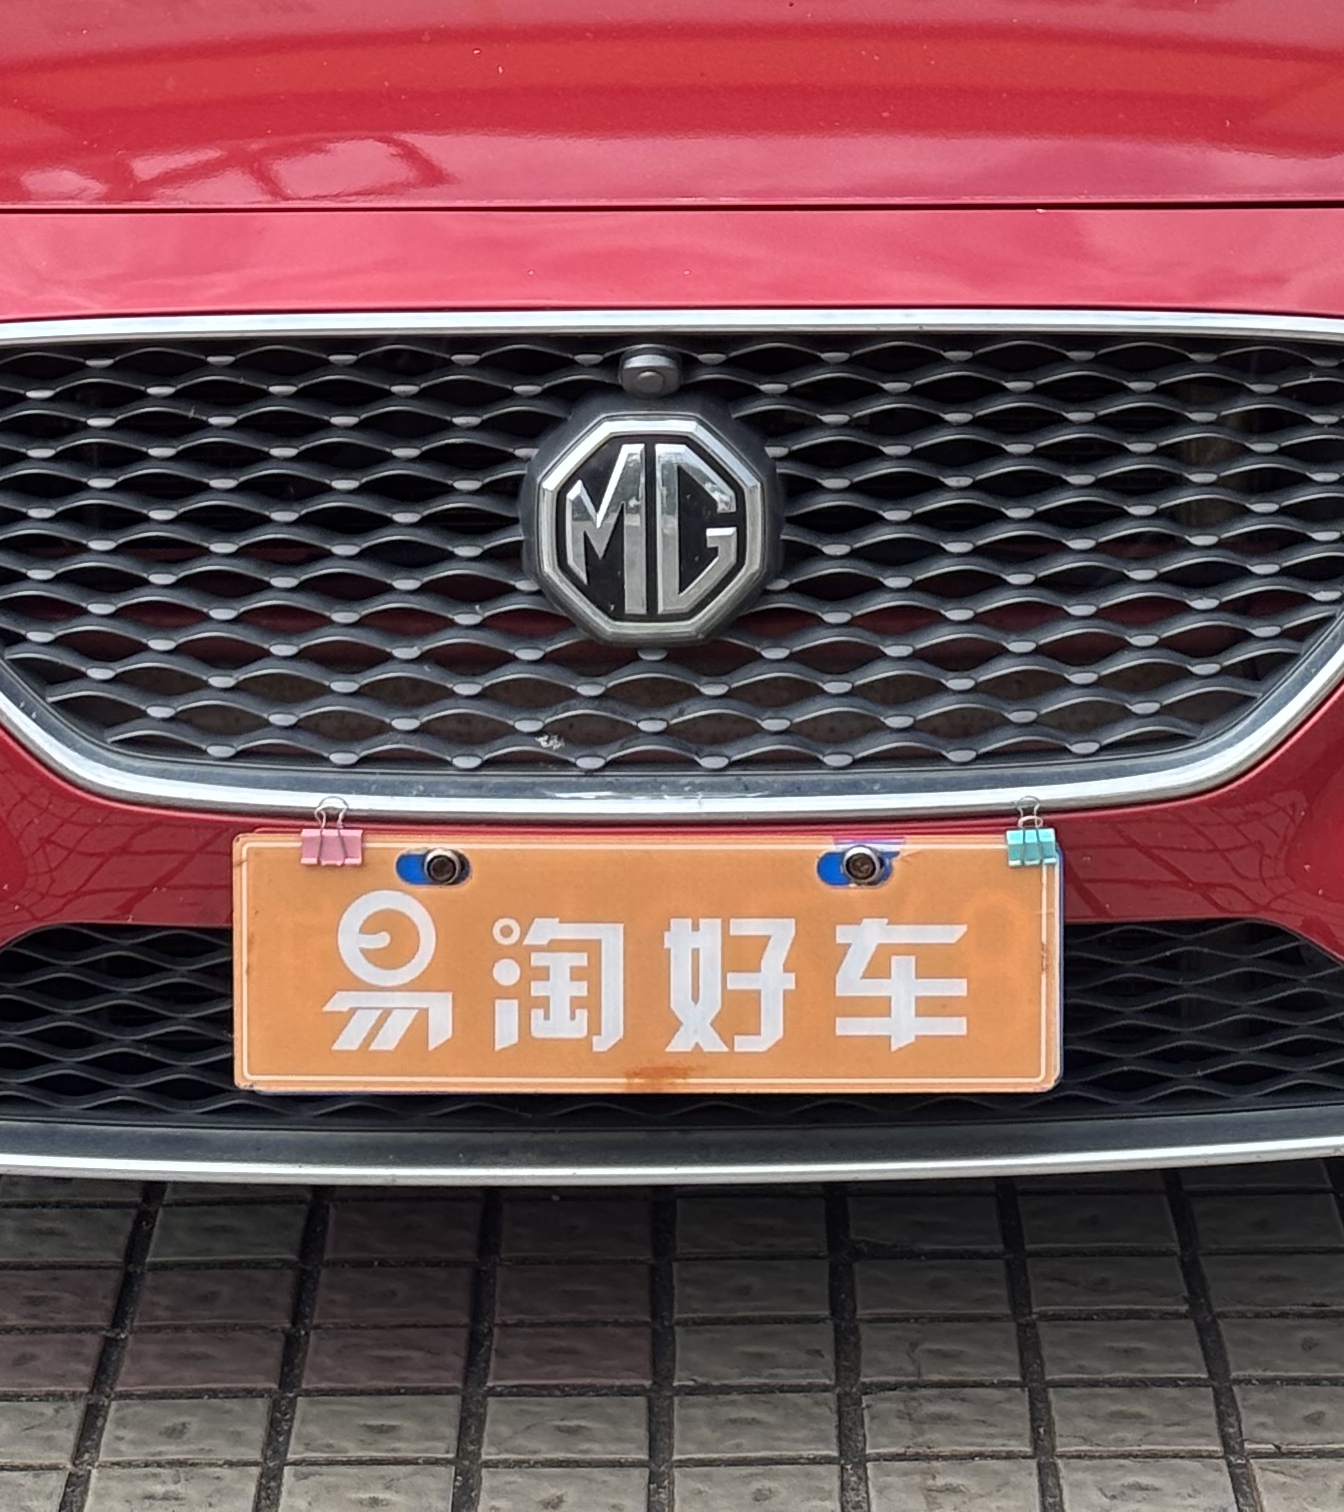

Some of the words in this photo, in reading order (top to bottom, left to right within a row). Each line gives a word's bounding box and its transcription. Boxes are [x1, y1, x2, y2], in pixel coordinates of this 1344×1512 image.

[566, 443, 738, 615] MG
[321, 889, 970, 1055] 易淘好车
